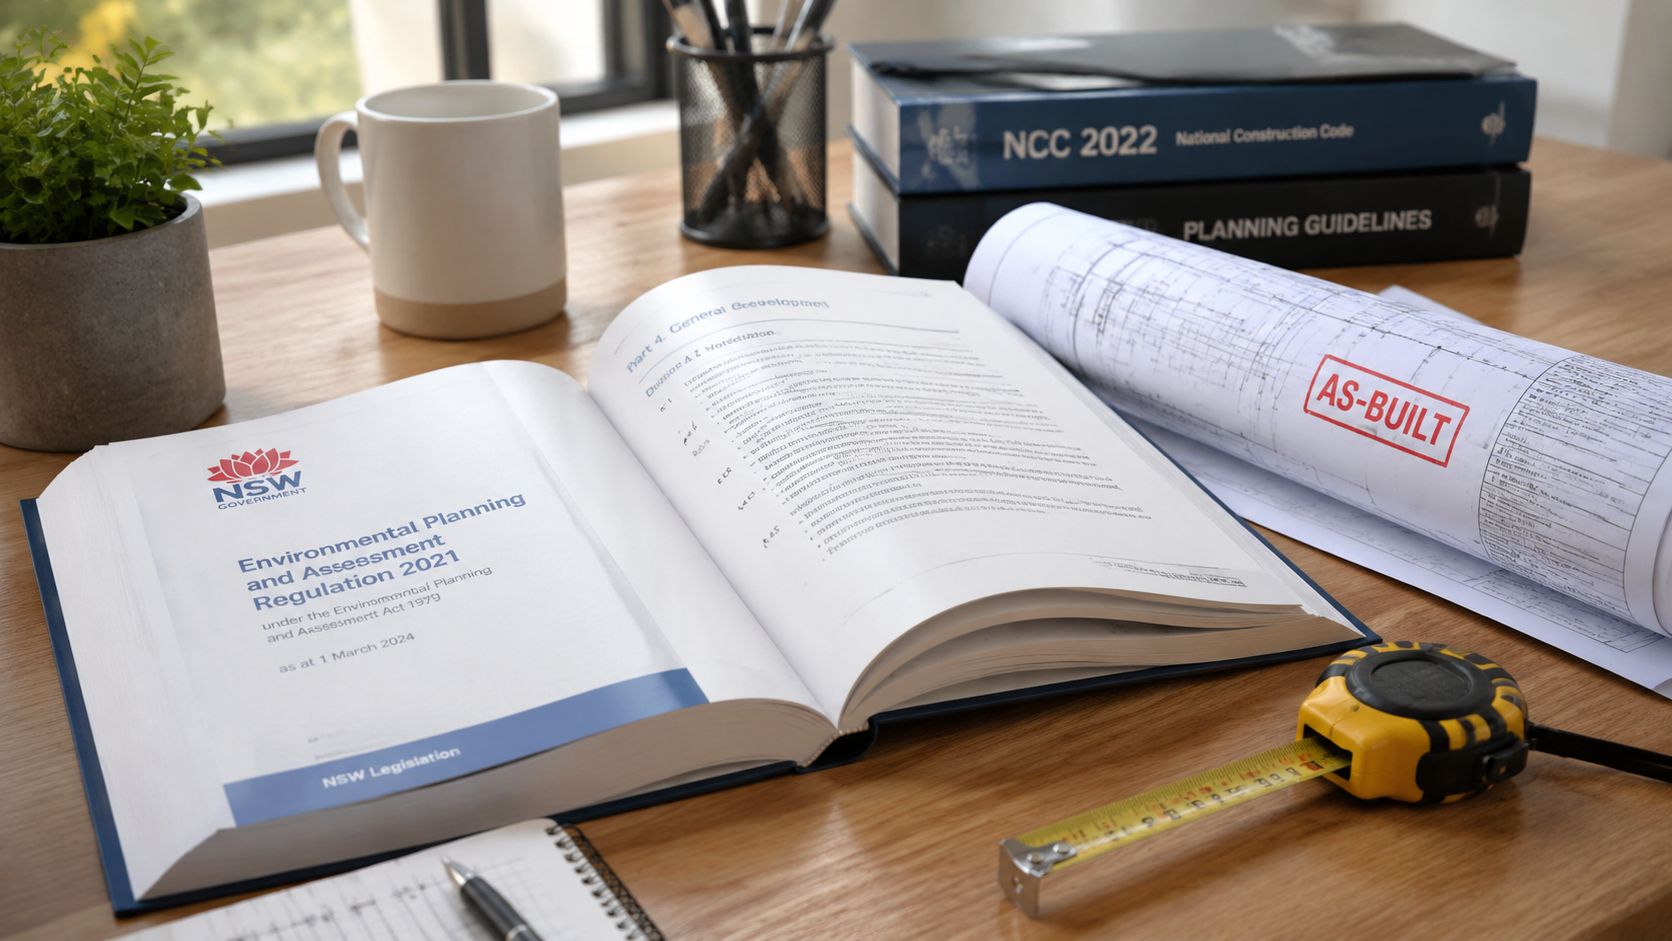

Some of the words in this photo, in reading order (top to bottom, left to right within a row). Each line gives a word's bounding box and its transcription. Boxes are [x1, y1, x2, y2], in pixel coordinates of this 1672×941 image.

[1003, 129, 1072, 161] NCC
[1079, 124, 1158, 157] 2022
[1176, 130, 1232, 146] National
[1233, 126, 1318, 143] Construction
[1320, 123, 1355, 138] Code
[1183, 216, 1299, 242] PLANNING
[1304, 210, 1433, 236] GUIDELINES
[669, 305, 727, 334] General
[1316, 373, 1452, 446] AS-BUILT
[212, 471, 302, 503] NSW
[218, 487, 307, 510] GOVERNMENT
[238, 521, 418, 573] Environmental
[422, 493, 527, 530] Planning
[247, 571, 295, 592] and
[302, 534, 446, 581] Assessment
[253, 570, 395, 611] Regulation
[401, 549, 460, 577] 2021
[262, 615, 304, 631] under
[307, 610, 330, 621] the
[434, 565, 493, 588] Planning
[266, 631, 294, 643] and
[382, 602, 405, 616] Act
[408, 592, 441, 608] 1979
[279, 664, 296, 674] as
[300, 658, 315, 669] at
[319, 655, 328, 664] 1
[332, 644, 378, 662] March
[381, 632, 415, 649] 2024
[322, 768, 365, 789] NSW
[369, 747, 461, 778] Legislation
